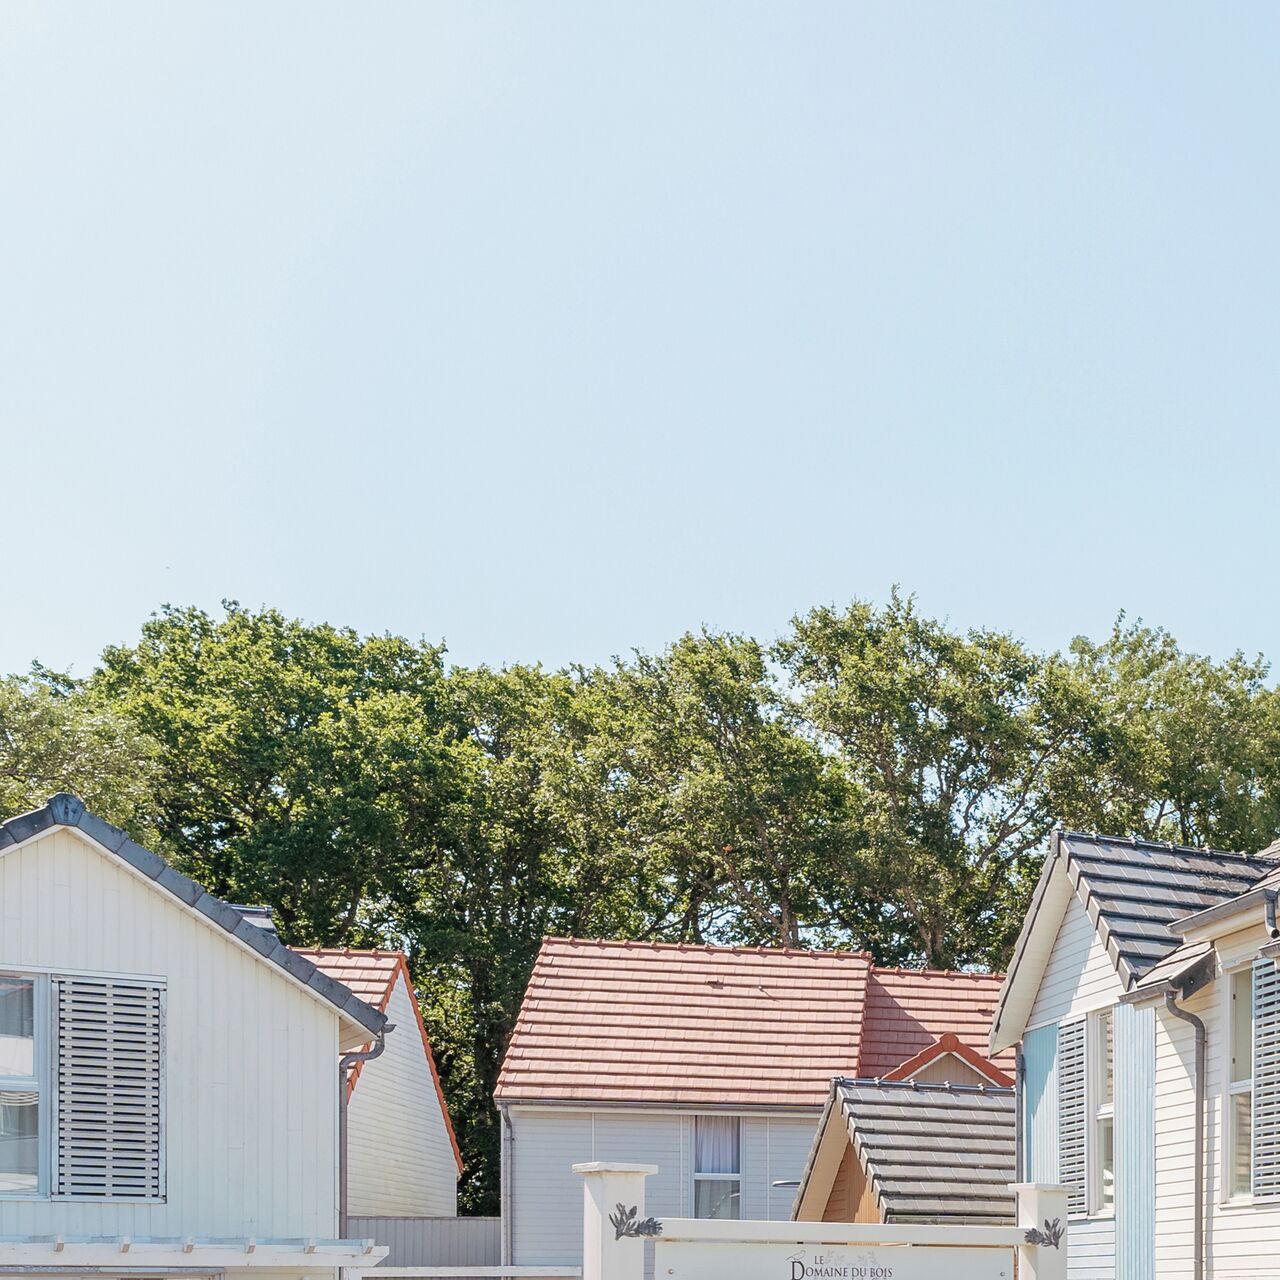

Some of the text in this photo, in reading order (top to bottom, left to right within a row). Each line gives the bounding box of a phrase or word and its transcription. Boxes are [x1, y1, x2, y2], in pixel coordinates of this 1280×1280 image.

[814, 1255, 824, 1265] LE
[791, 1260, 893, 1280] DOMAINE DU BOIS
